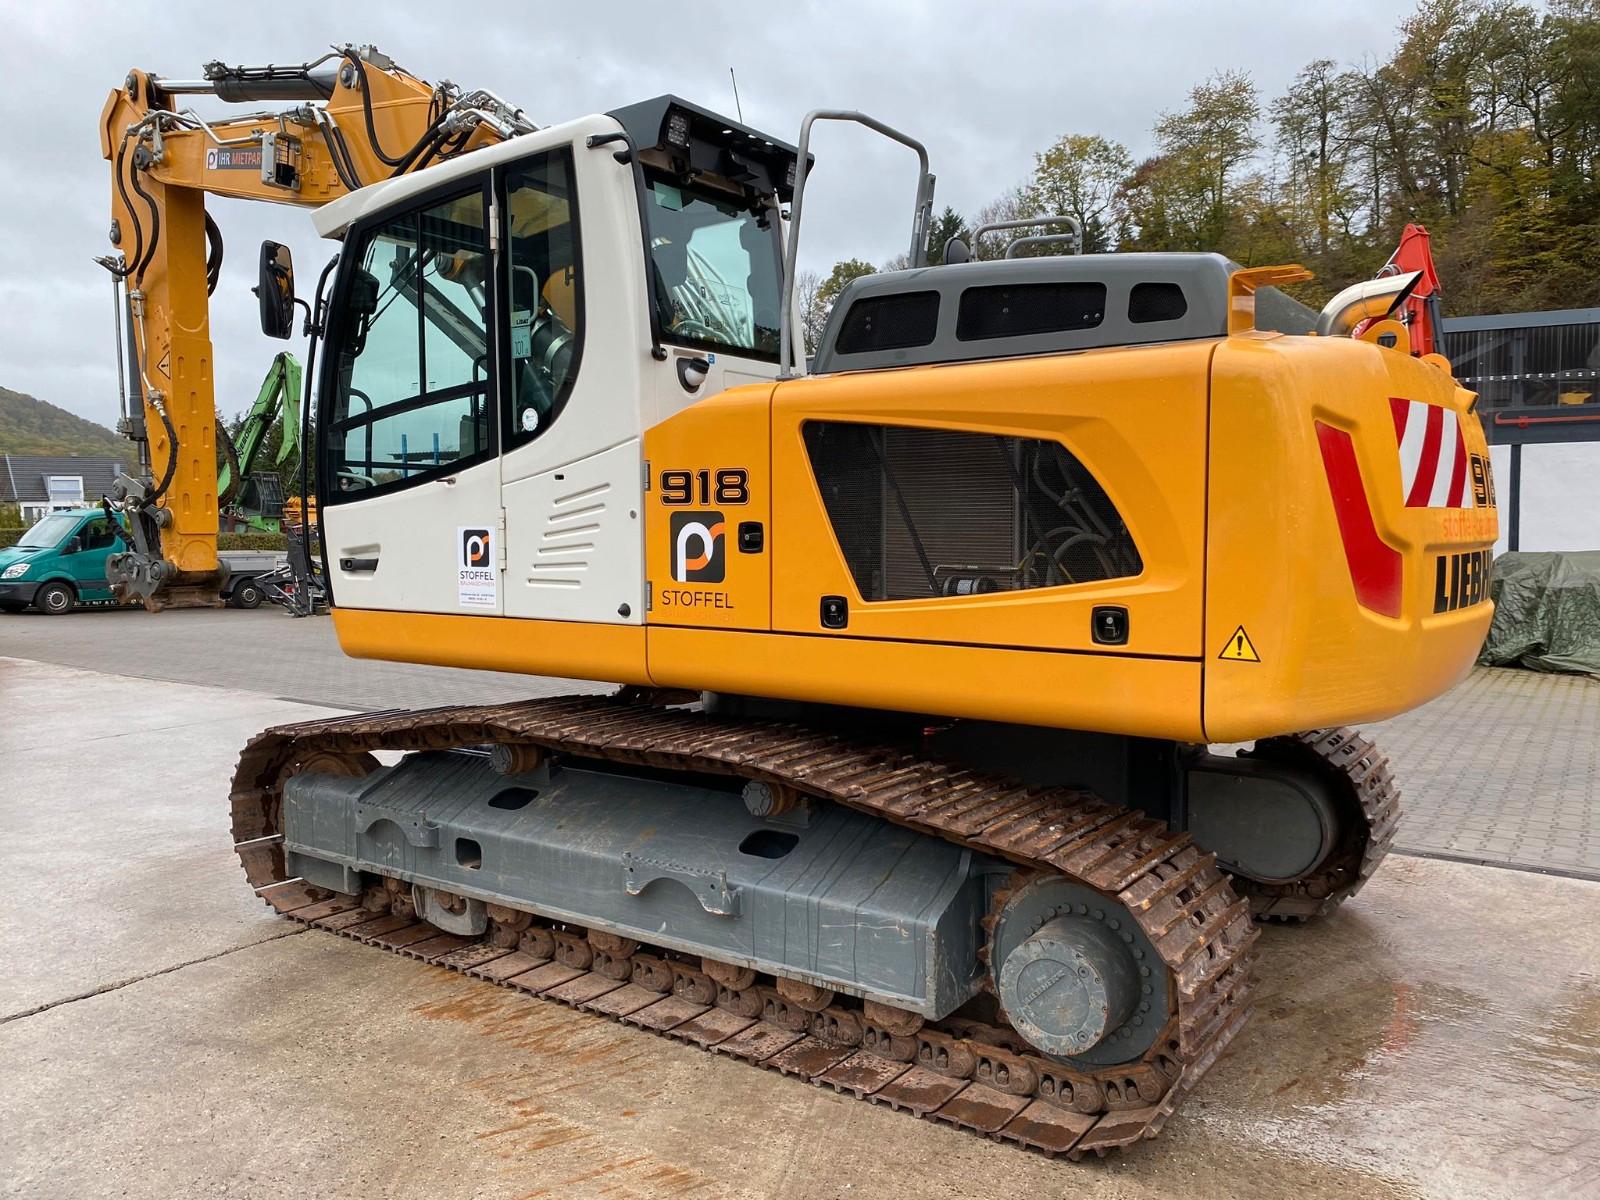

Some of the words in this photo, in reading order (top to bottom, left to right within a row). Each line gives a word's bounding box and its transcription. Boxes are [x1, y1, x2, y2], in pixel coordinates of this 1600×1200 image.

[231, 151, 261, 165] MIETPAR
[660, 468, 750, 506] 918
[460, 570, 494, 581] STOFFEL
[1433, 550, 1493, 614] LIEBH
[662, 590, 734, 609] STOFFEL
